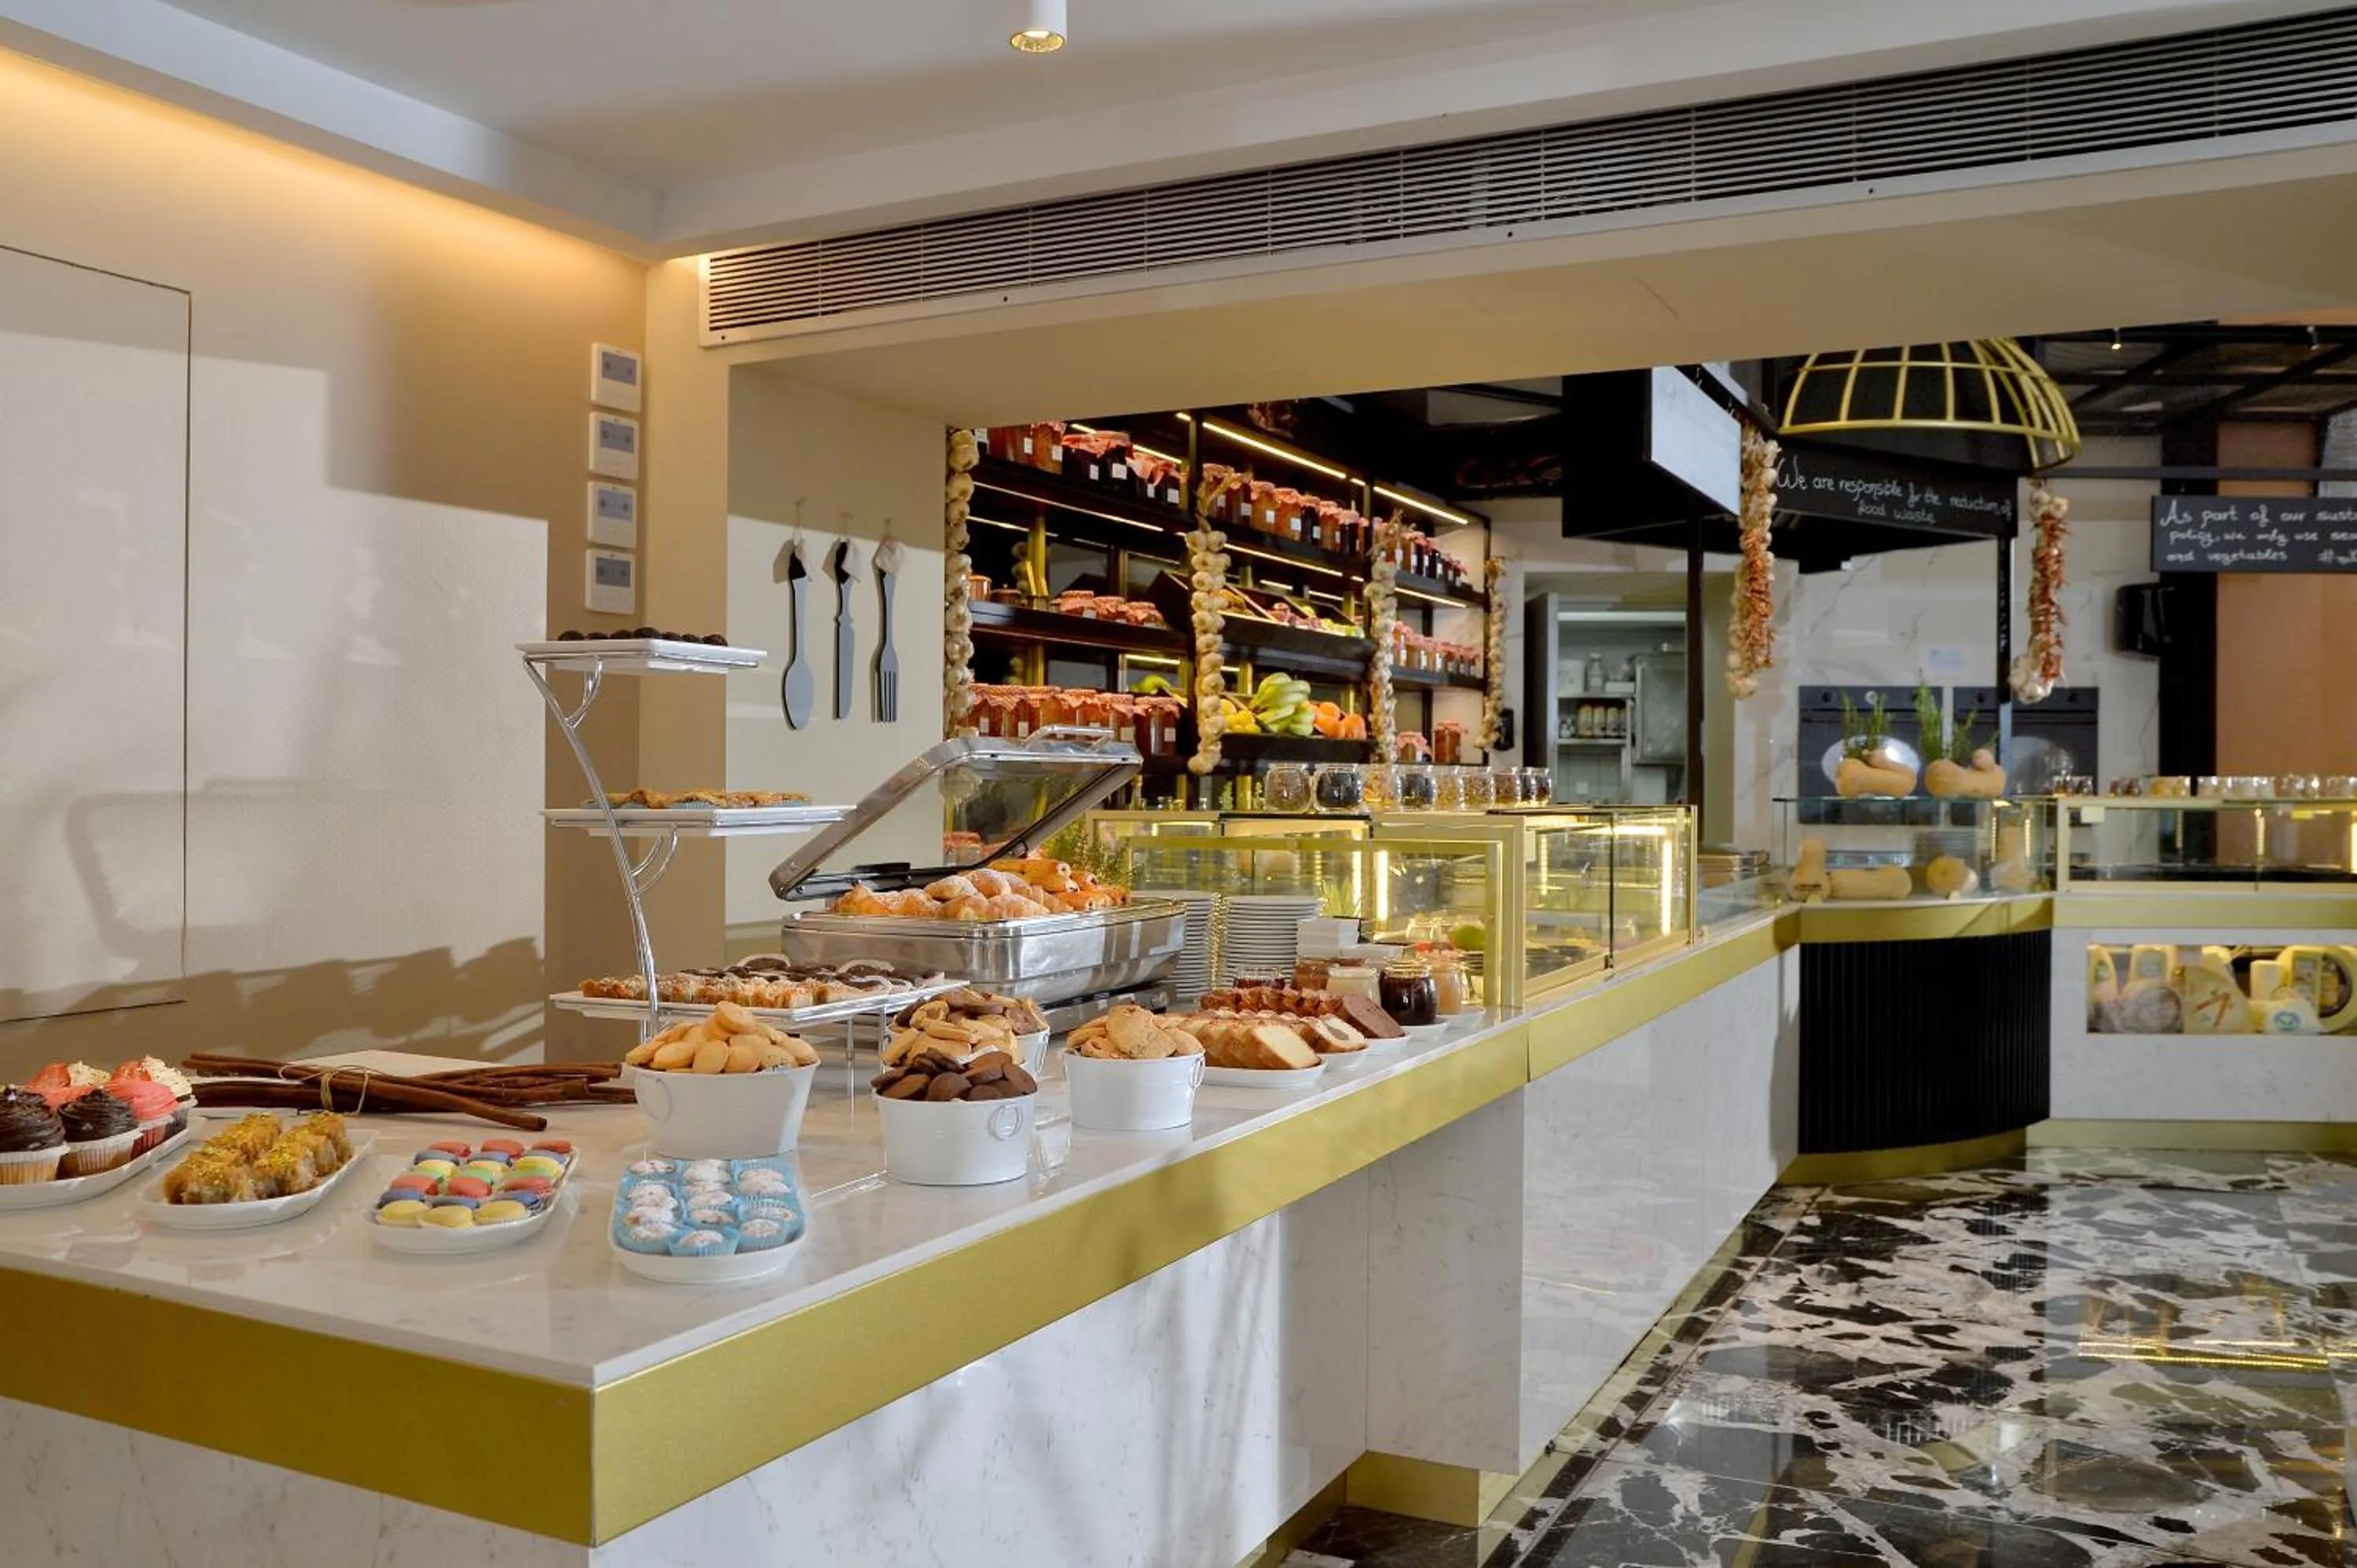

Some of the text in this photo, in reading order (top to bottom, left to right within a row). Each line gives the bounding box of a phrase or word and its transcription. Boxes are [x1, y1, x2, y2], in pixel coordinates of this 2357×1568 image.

[1777, 455, 1807, 490] We
[1812, 477, 1835, 491] are
[1839, 478, 1903, 502] responsible
[1907, 482, 1923, 508] for
[1924, 488, 1943, 506] the
[1857, 500, 1936, 524] food waste
[2160, 498, 2193, 527] As
[2201, 504, 2238, 529] part
[2249, 504, 2270, 528] of
[2280, 511, 2306, 522] our
[2223, 531, 2246, 541] we
[2256, 527, 2290, 548] only
[2293, 530, 2319, 541] use
[2166, 548, 2289, 566] and vegetables
